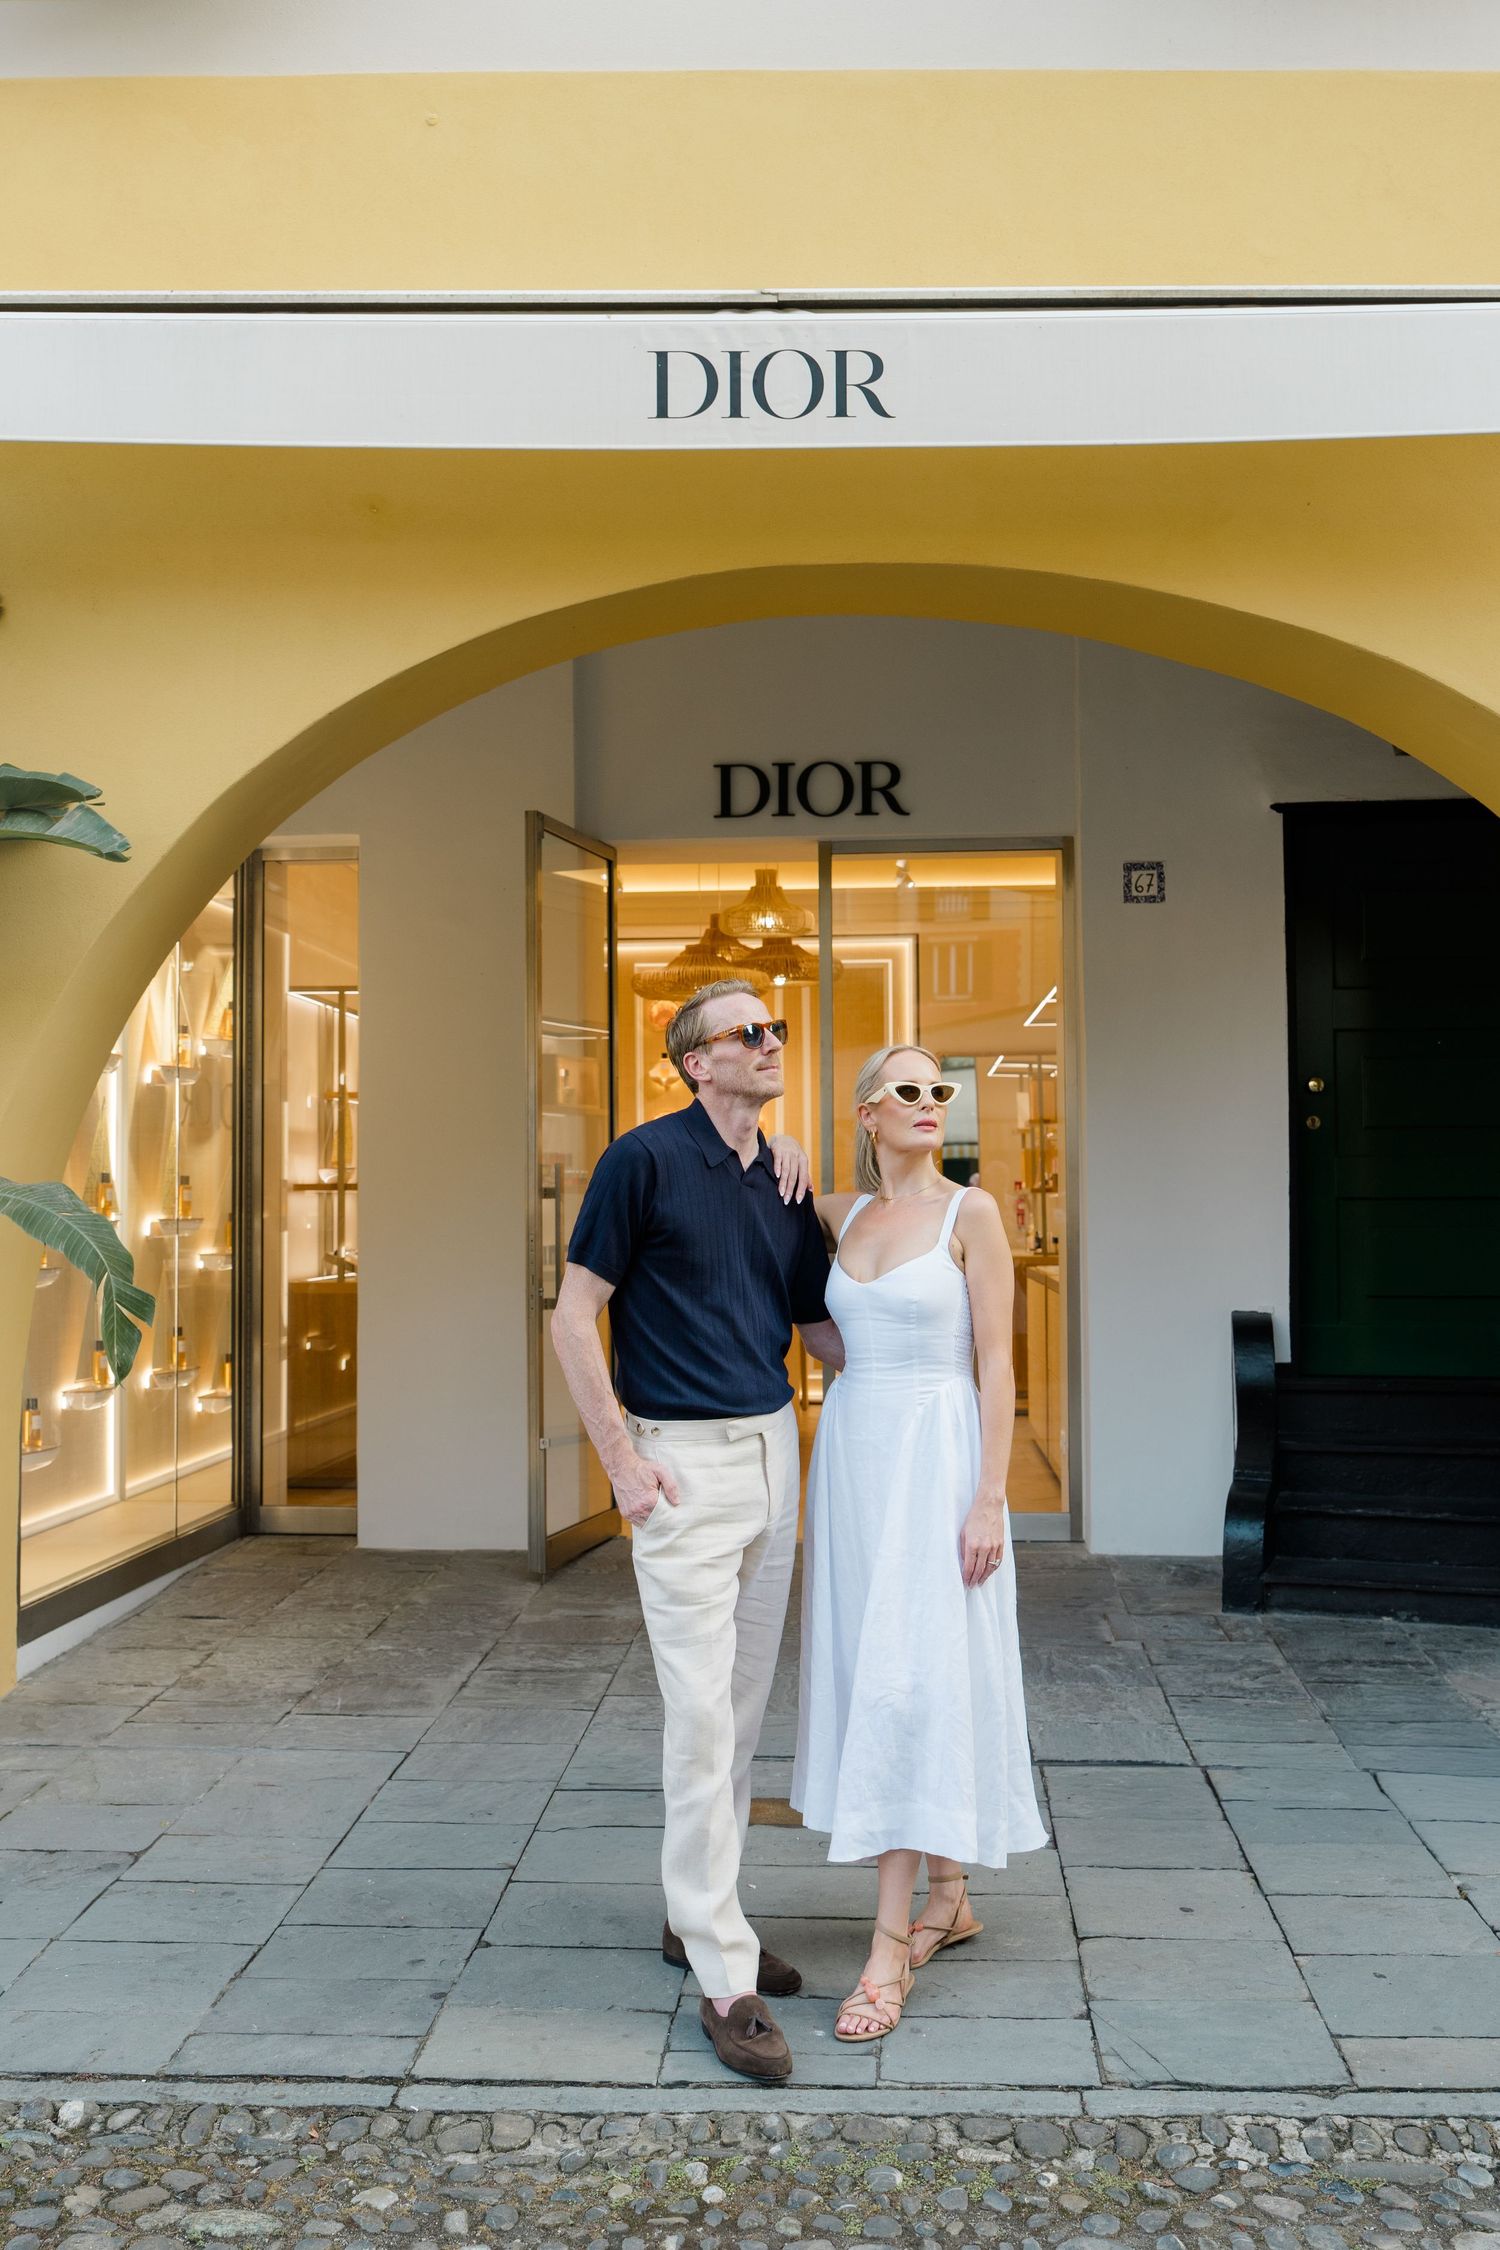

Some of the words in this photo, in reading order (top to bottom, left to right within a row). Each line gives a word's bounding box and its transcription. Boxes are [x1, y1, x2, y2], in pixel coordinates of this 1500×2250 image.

[647, 349, 896, 420] DIOR
[713, 760, 911, 819] DIOR
[1134, 873, 1155, 894] 67
